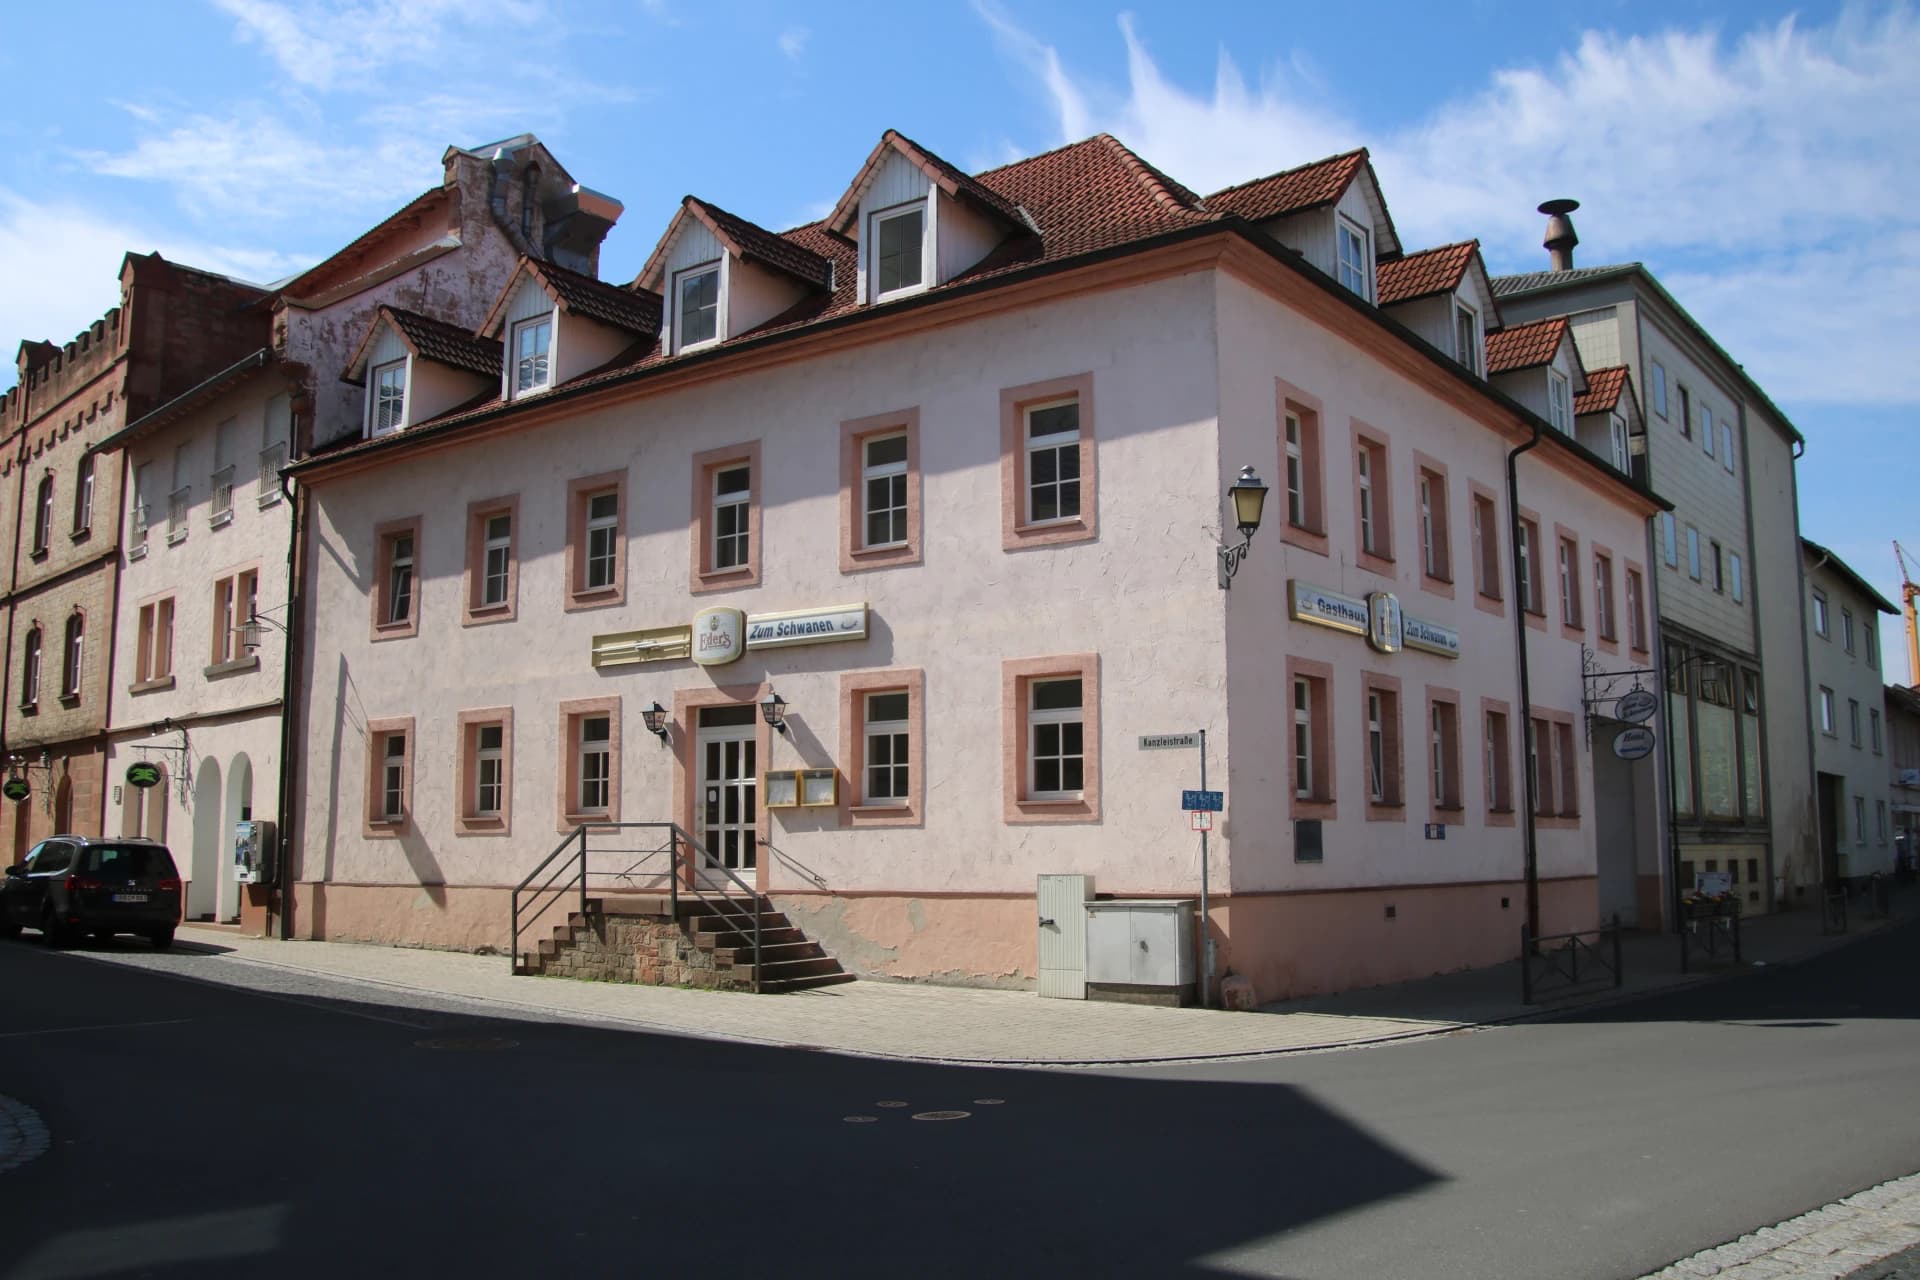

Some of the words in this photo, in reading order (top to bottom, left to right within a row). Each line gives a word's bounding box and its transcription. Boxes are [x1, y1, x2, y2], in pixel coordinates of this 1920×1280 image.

[1318, 598, 1366, 623] Gasthaus
[750, 625, 774, 639] Zum
[777, 620, 834, 636] Schwanen
[1406, 622, 1420, 638] Zum
[1420, 624, 1447, 645] Schwanen
[700, 631, 732, 652] Eder's
[1144, 736, 1193, 747] Kanzleistraße
